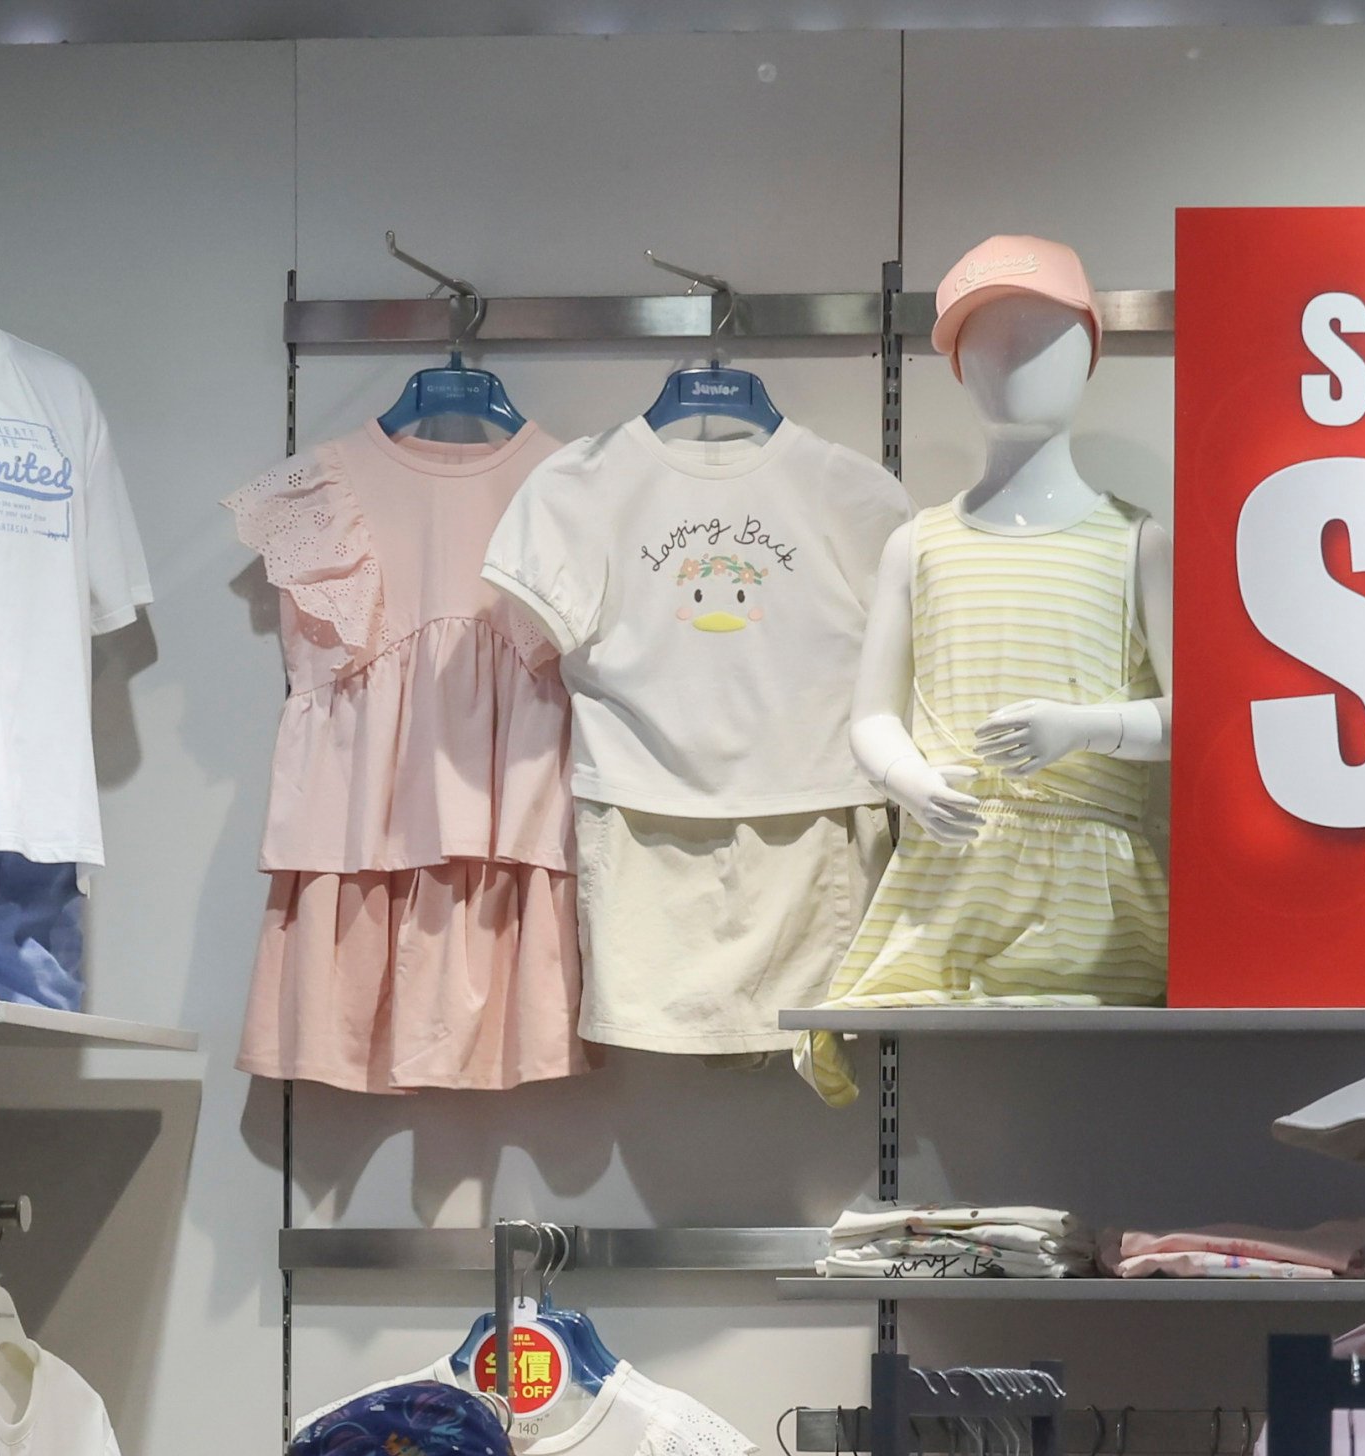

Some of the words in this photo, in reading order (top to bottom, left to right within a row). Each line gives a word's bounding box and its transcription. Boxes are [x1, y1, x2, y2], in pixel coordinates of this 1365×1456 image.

[692, 381, 739, 396] Junior
[734, 514, 797, 572] Back
[522, 1385, 553, 1398] OFF
[517, 1422, 539, 1436] 140
